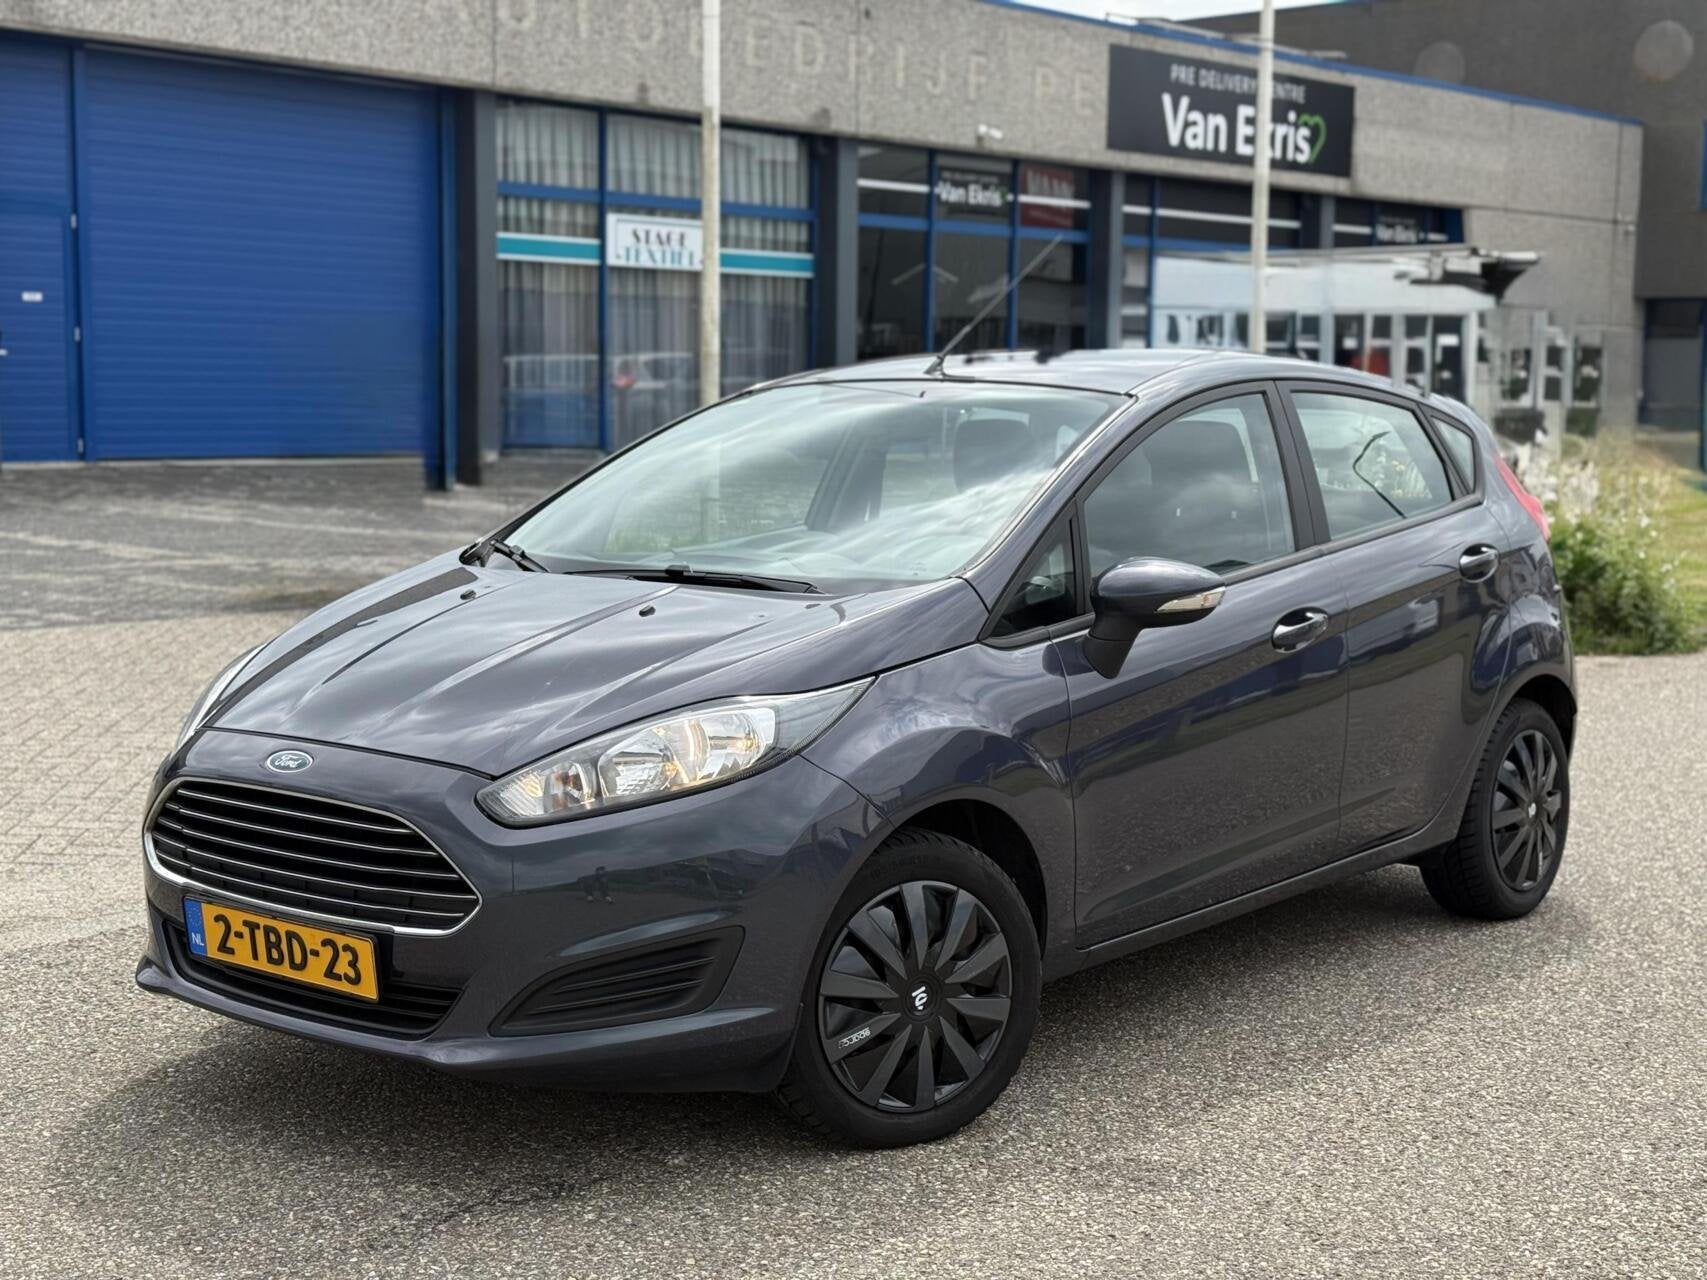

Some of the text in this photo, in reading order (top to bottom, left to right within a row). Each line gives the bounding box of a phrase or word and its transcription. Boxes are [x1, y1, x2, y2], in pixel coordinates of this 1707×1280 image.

[1169, 63, 1306, 104] PRE DELIVERY NTRE
[1161, 92, 1311, 163] Van Eris
[274, 753, 302, 768] Ford
[191, 914, 361, 986] NL 2-TBD-23
